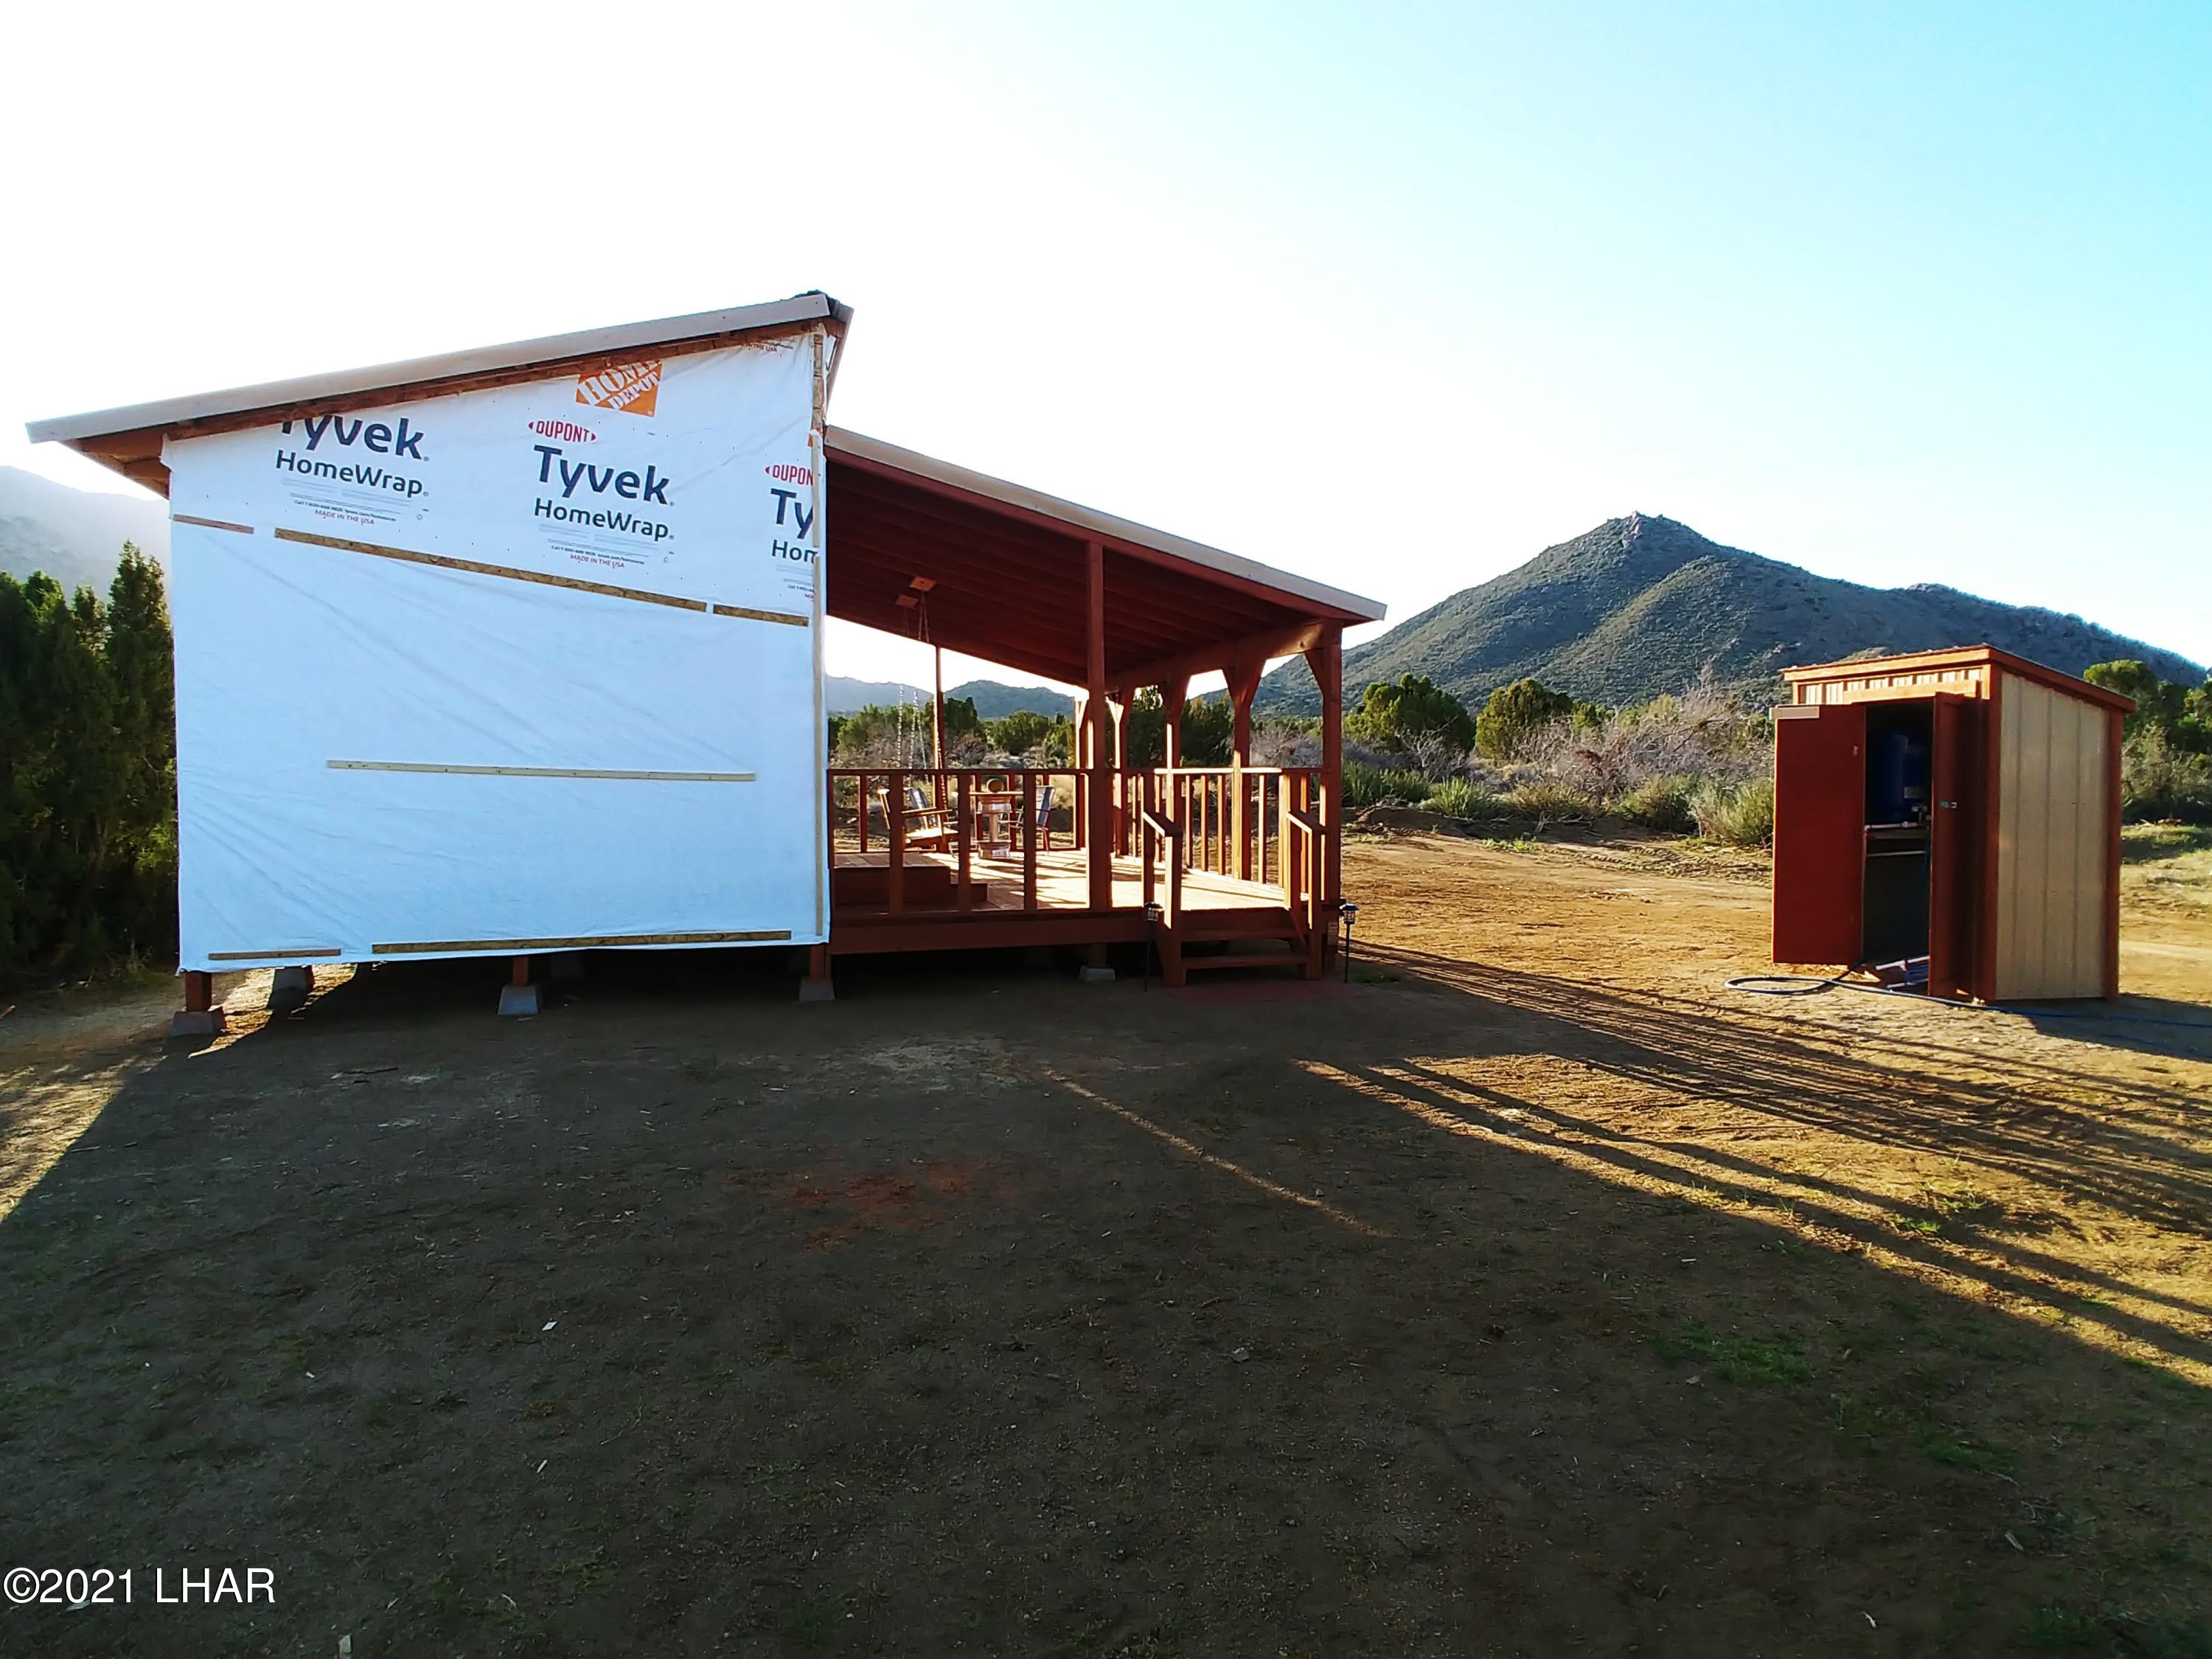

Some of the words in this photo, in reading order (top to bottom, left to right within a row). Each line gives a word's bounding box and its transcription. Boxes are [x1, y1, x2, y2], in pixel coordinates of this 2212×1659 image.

[608, 372, 659, 409] DEPOT
[536, 421, 590, 442] DUPONT
[276, 450, 422, 498] HomeWrap
[534, 445, 669, 504] Tyvek
[315, 509, 336, 518] MADE
[535, 498, 668, 541] HomeWrap
[771, 488, 813, 539] Ty
